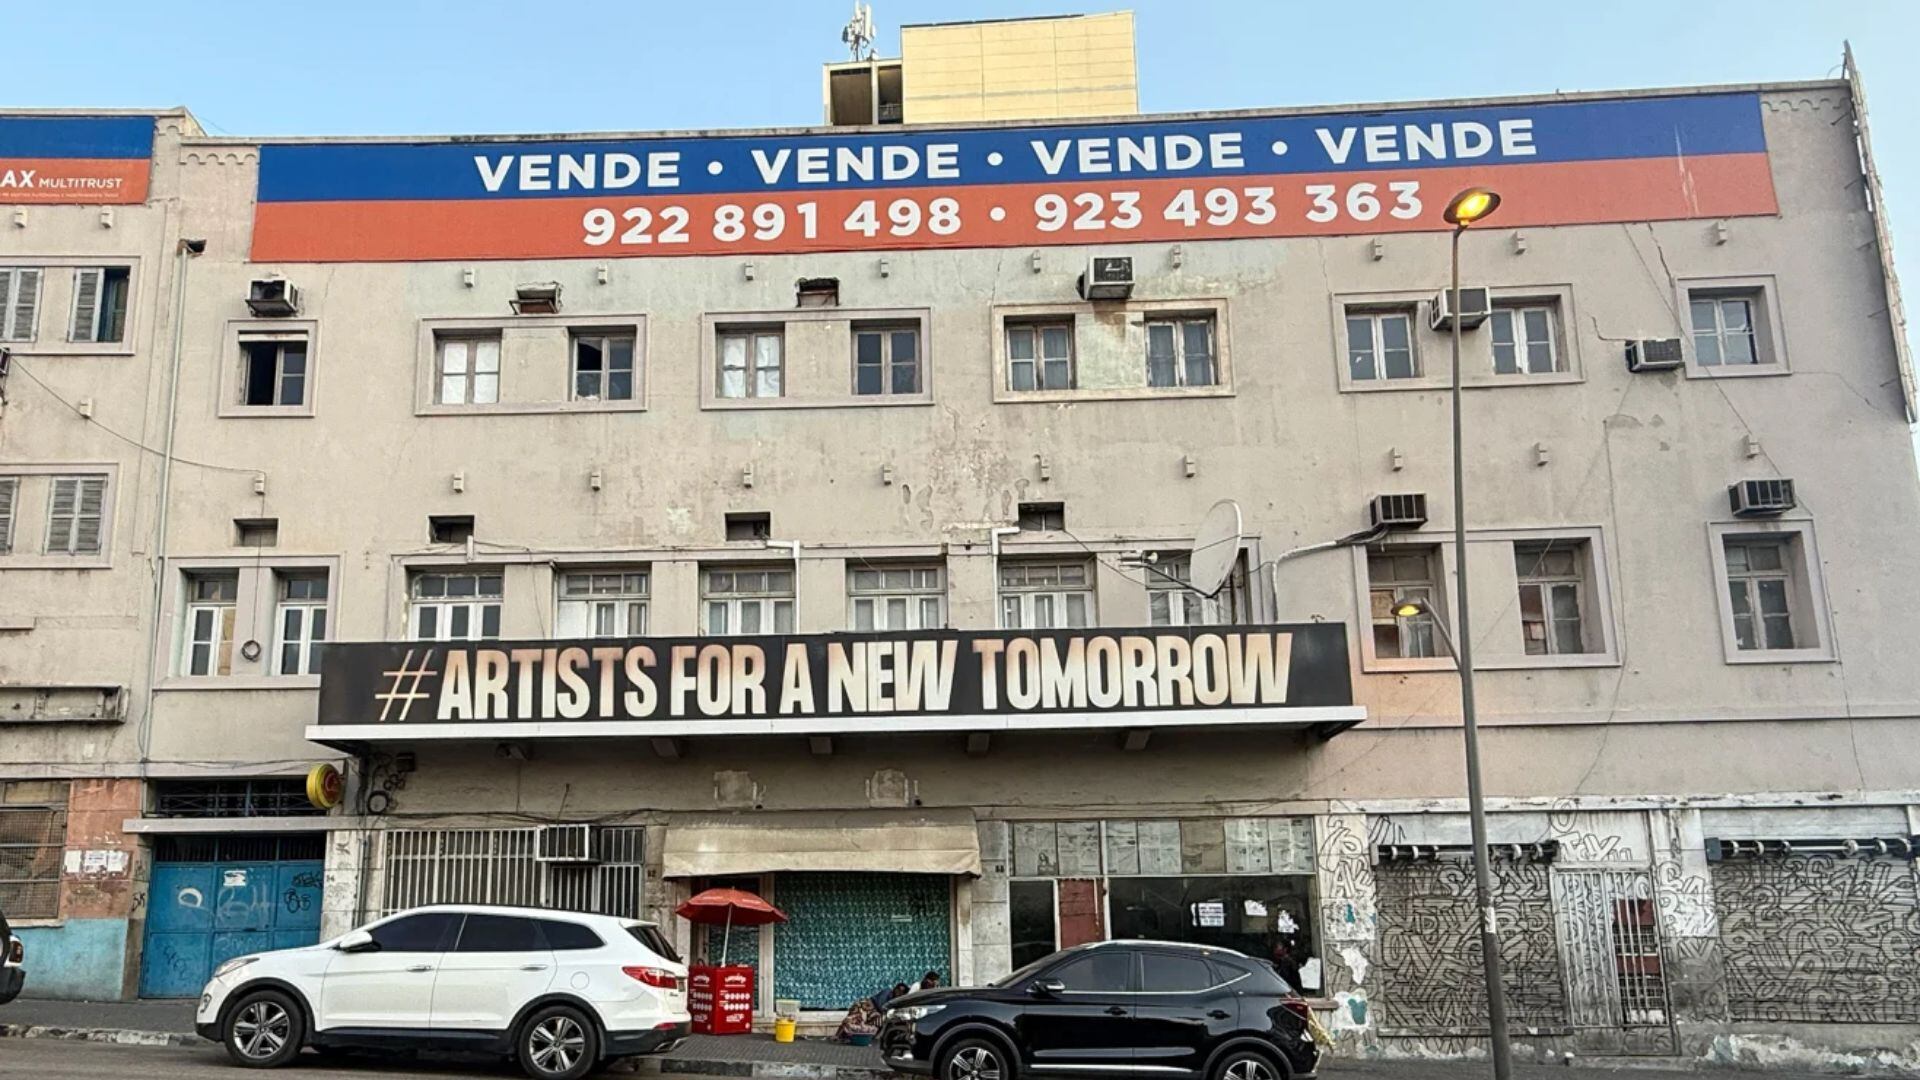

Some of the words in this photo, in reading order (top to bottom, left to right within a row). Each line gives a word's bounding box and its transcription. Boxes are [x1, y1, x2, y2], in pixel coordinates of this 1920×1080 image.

[39, 177, 122, 189] MULTITRUST
[474, 153, 680, 191] VENDE
[751, 145, 960, 184] VENDE
[1030, 133, 1244, 175] VENDE
[1315, 120, 1537, 164] VENDE
[583, 207, 690, 246] 922
[712, 203, 817, 242] 891
[843, 198, 961, 237] 498
[1034, 192, 1143, 231] 923
[1163, 187, 1277, 226] 493
[1305, 181, 1423, 222] 363
[374, 645, 658, 722] #ARTISTS
[670, 644, 767, 716] FOR
[778, 642, 817, 716] A
[827, 639, 959, 713] NEW
[972, 633, 1294, 710] TOMORROW
